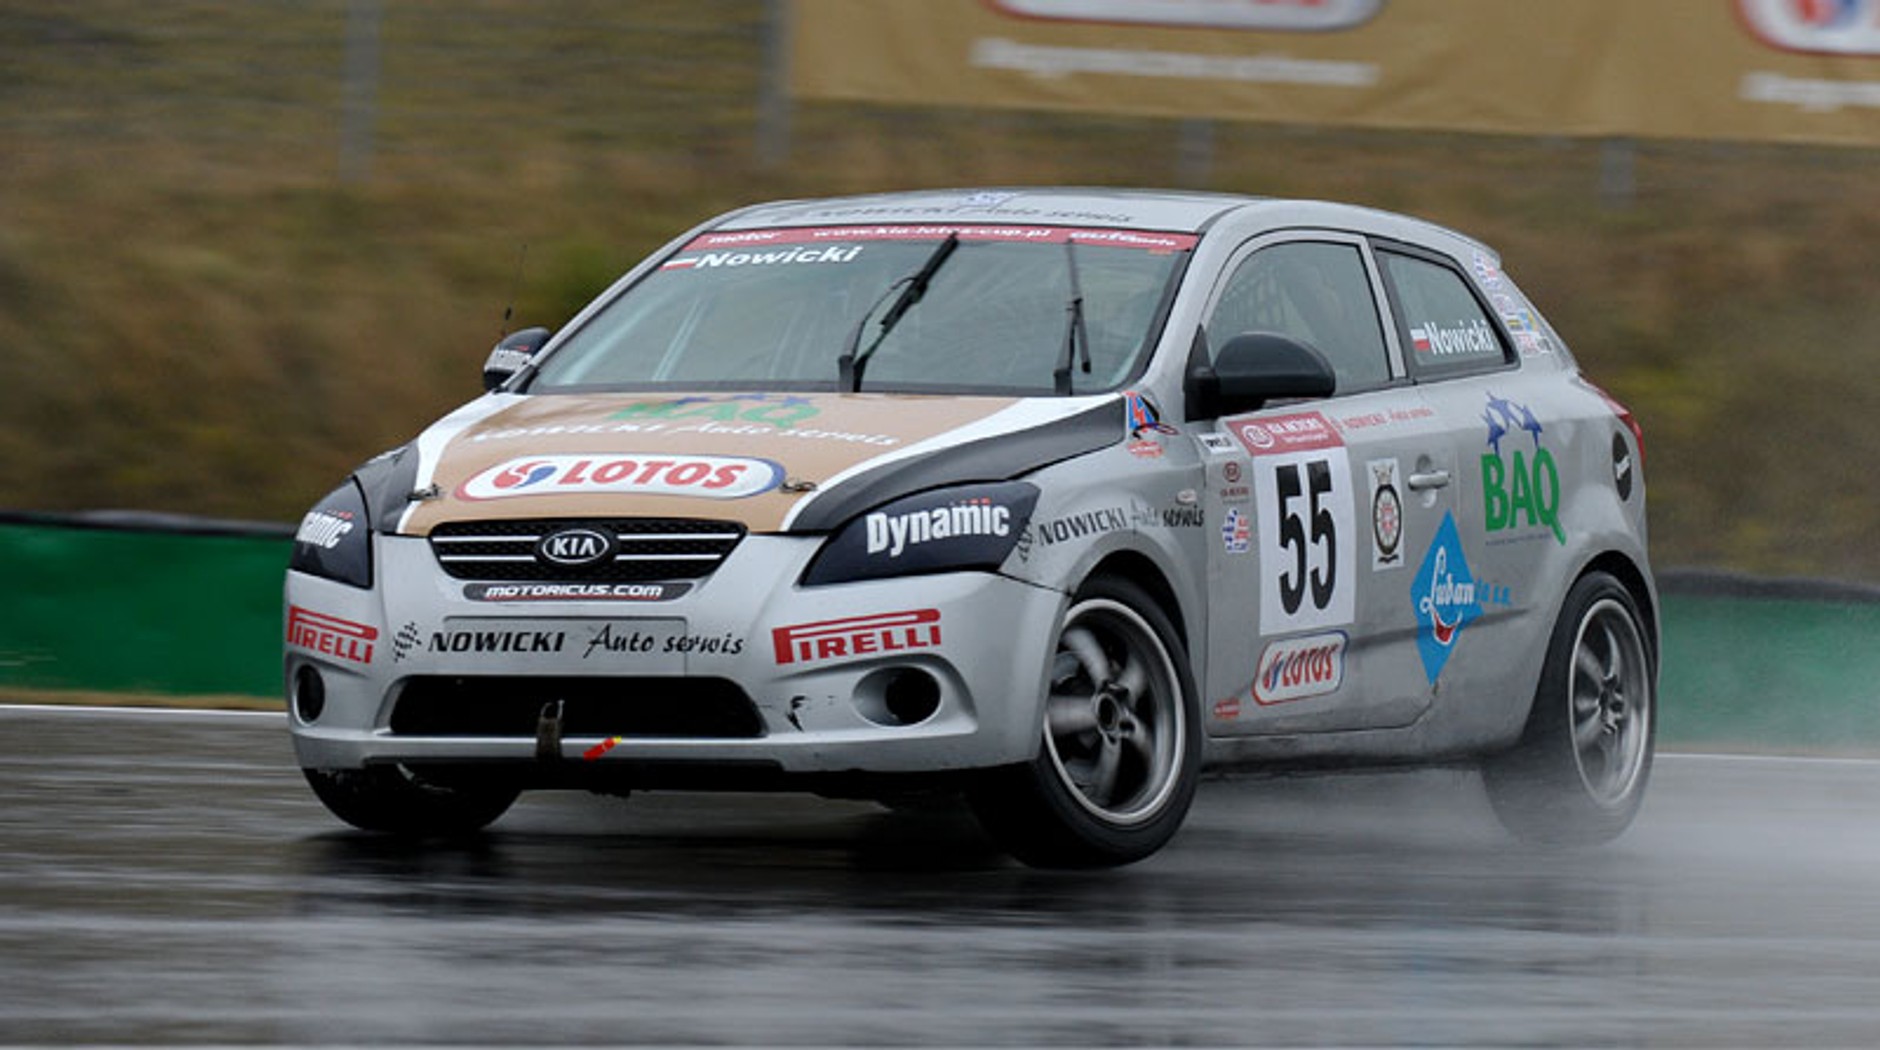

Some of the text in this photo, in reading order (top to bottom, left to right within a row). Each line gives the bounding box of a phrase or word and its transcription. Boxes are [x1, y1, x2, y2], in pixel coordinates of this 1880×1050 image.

[694, 246, 864, 268] Nowicki
[1423, 319, 1495, 355] Nowicki
[558, 459, 748, 490] LOTOS
[1481, 446, 1567, 547] BAQ
[866, 502, 1010, 557] Dynamic
[1039, 507, 1127, 546] NOWICKI
[1163, 503, 1205, 528] serwis
[1276, 459, 1337, 615] 55
[552, 537, 597, 557] KIA
[287, 605, 379, 664] PIRELLI
[428, 623, 745, 659] NOWICKI Auto serwis
[772, 608, 942, 665] PIRELLI
[1282, 643, 1340, 688] LOTOS
